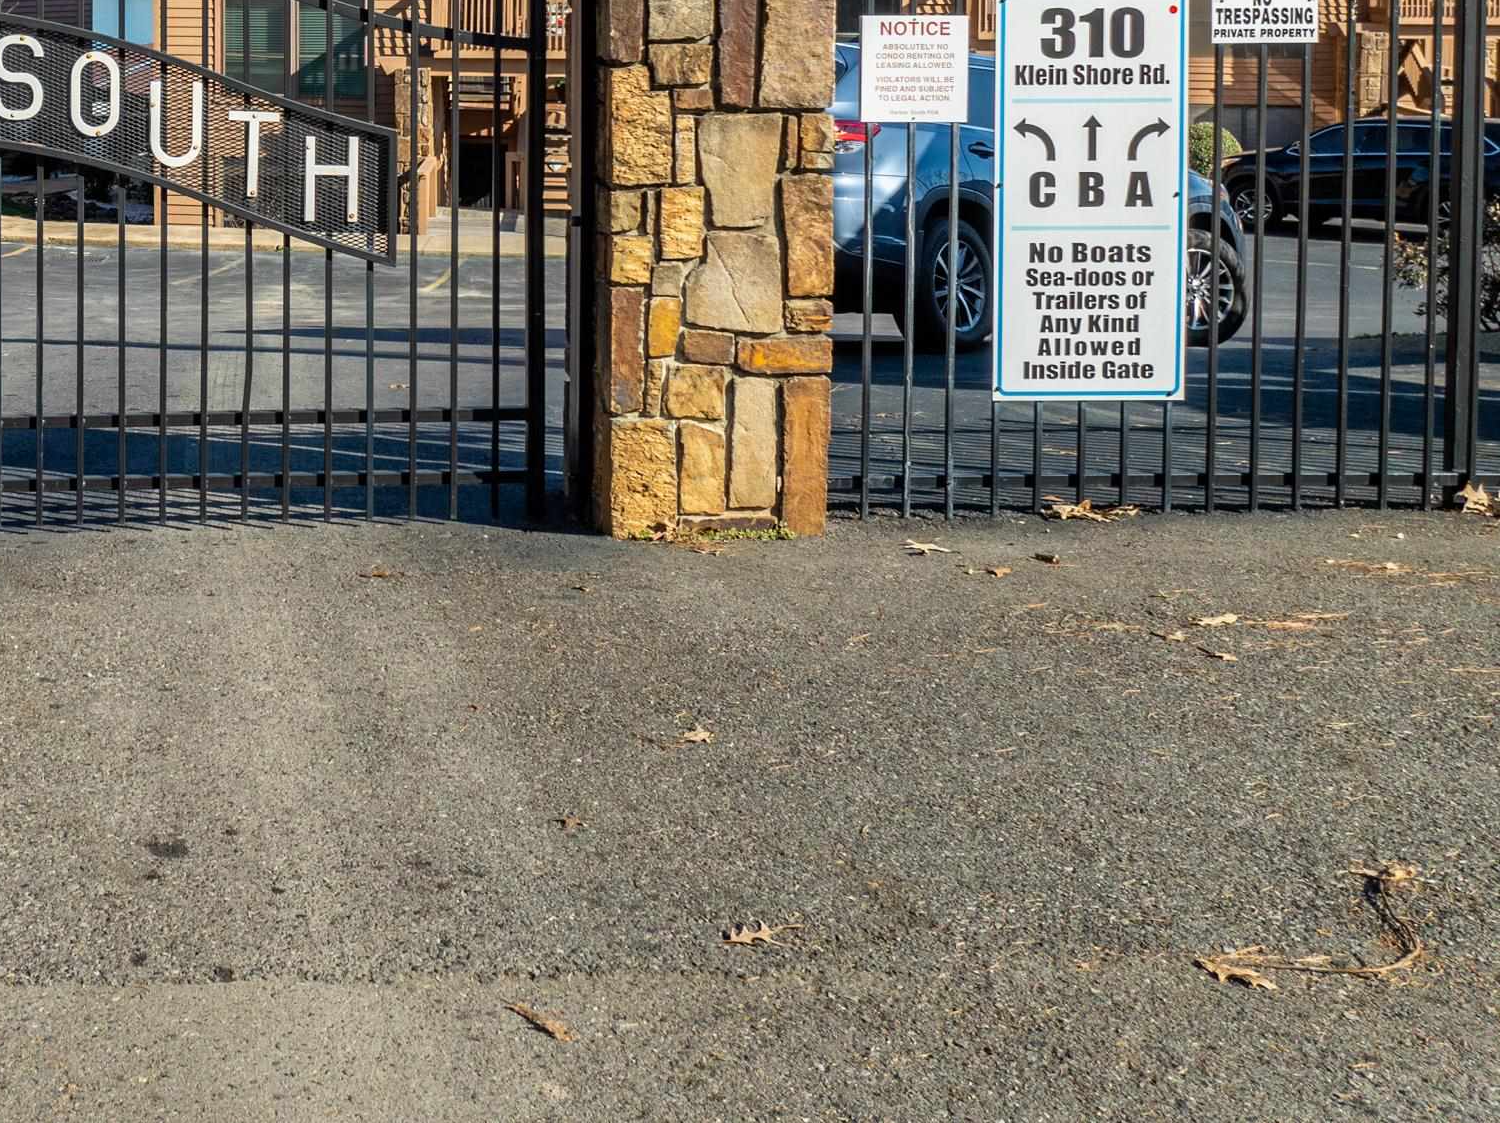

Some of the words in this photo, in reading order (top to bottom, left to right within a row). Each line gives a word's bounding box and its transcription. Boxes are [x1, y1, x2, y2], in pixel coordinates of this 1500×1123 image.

[1216, 7, 1313, 25] TRESPASSING
[880, 21, 951, 36] NOTICE
[1040, 7, 1145, 59] 310
[1214, 28, 1256, 38] PRIVATE
[1260, 28, 1315, 37] PROPERTY
[1014, 65, 1067, 86] Klein
[1073, 64, 1134, 85] Shore
[1139, 64, 1170, 85] Rd.
[891, 94, 917, 102] LEGAL
[1029, 171, 1056, 208] C
[1078, 172, 1104, 207] B
[1124, 172, 1153, 207] A
[1029, 242, 1063, 263] No
[1071, 242, 1152, 263] Boats
[1026, 268, 1126, 286] Sea-doos
[1131, 270, 1155, 286] or
[1032, 291, 1120, 310] Trailers
[1125, 291, 1147, 309] of
[1039, 315, 1082, 335] Any
[1088, 314, 1139, 333] Kind
[1037, 338, 1141, 356] Allowed
[1023, 361, 1096, 379] Inside
[1102, 360, 1154, 379] Gate
